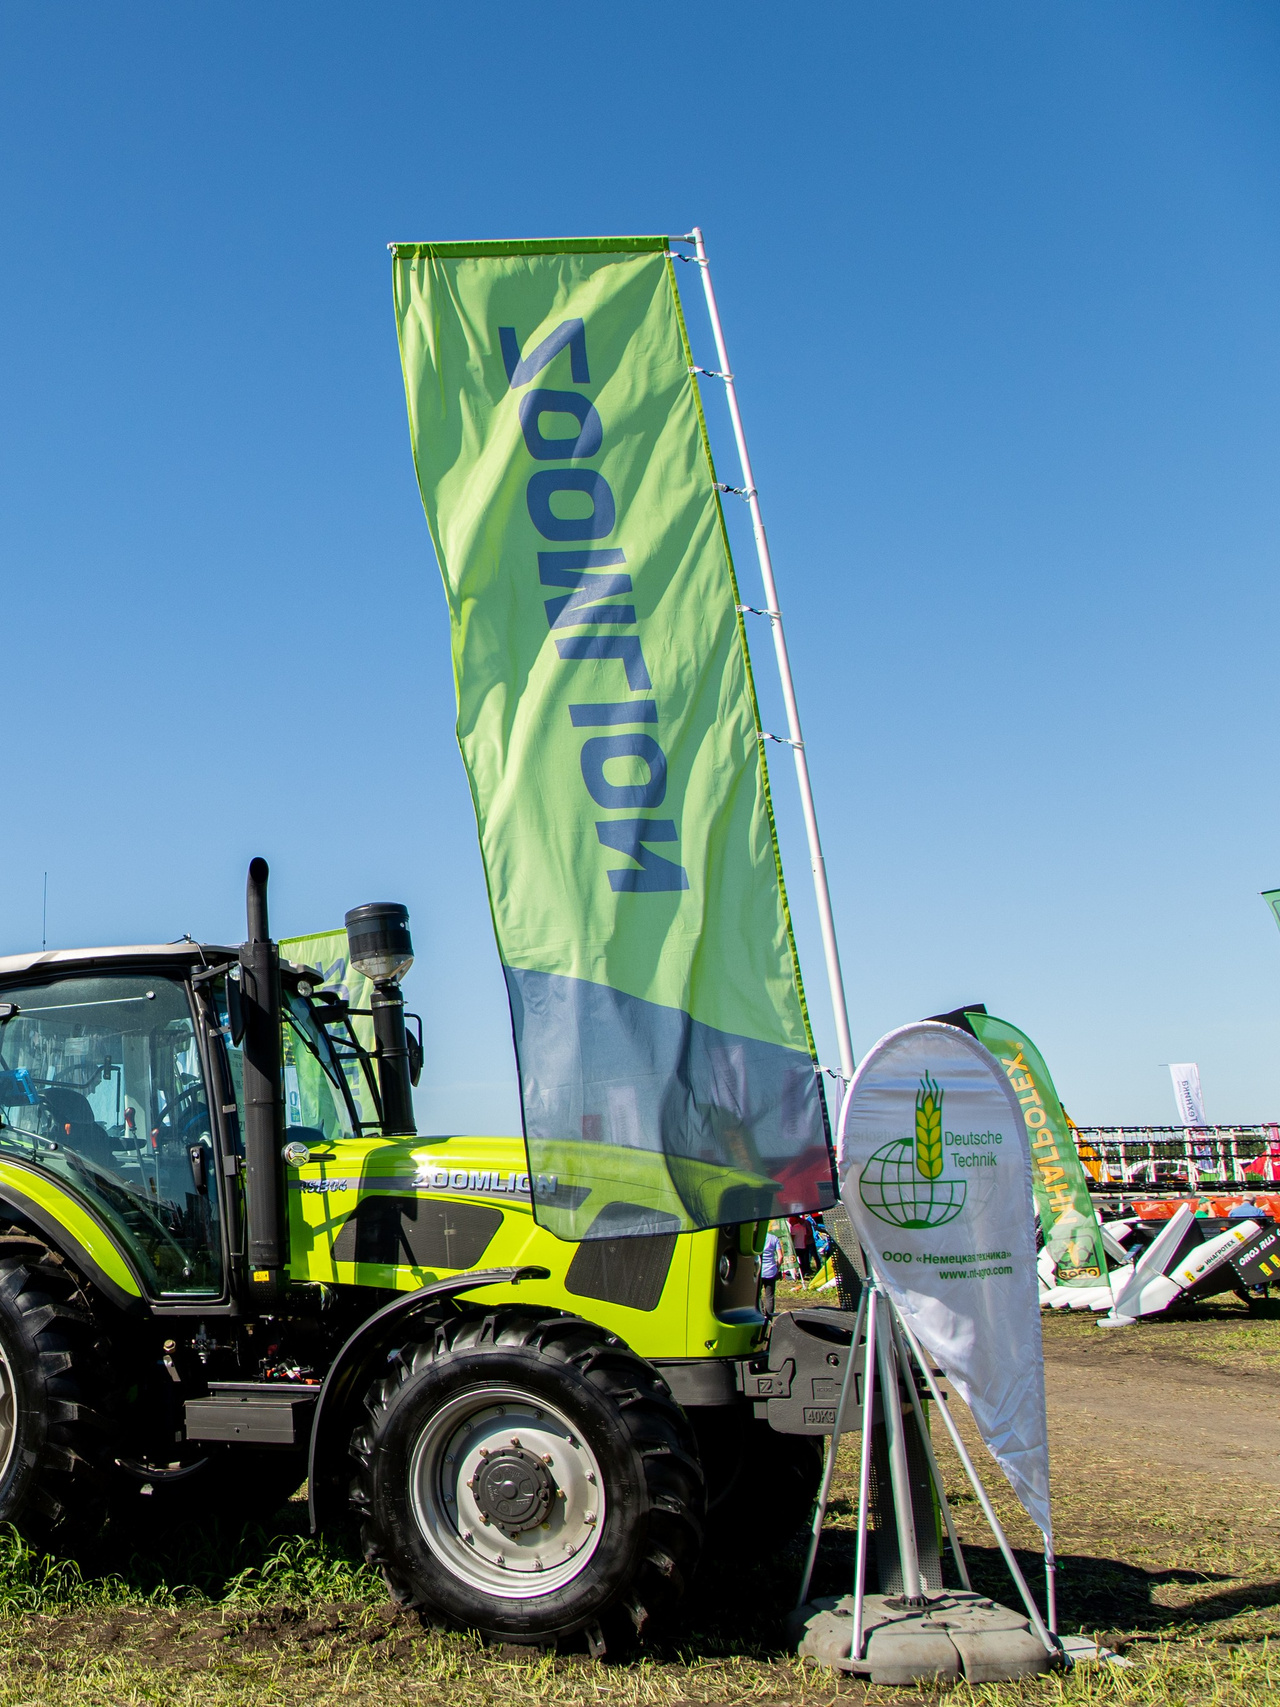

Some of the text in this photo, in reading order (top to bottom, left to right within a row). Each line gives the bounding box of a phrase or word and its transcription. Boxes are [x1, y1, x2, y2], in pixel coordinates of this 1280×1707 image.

[945, 1131, 1003, 1146] Deutsche
[951, 1152, 997, 1167] Technik
[411, 1169, 558, 1194] ZOOMLION
[882, 1251, 912, 1263] ООО
[916, 1253, 976, 1265] «Немецкая
[1204, 1239, 1236, 1265] ИНАГРОТЕХ
[939, 1266, 1013, 1280] www.nt-agro.com
